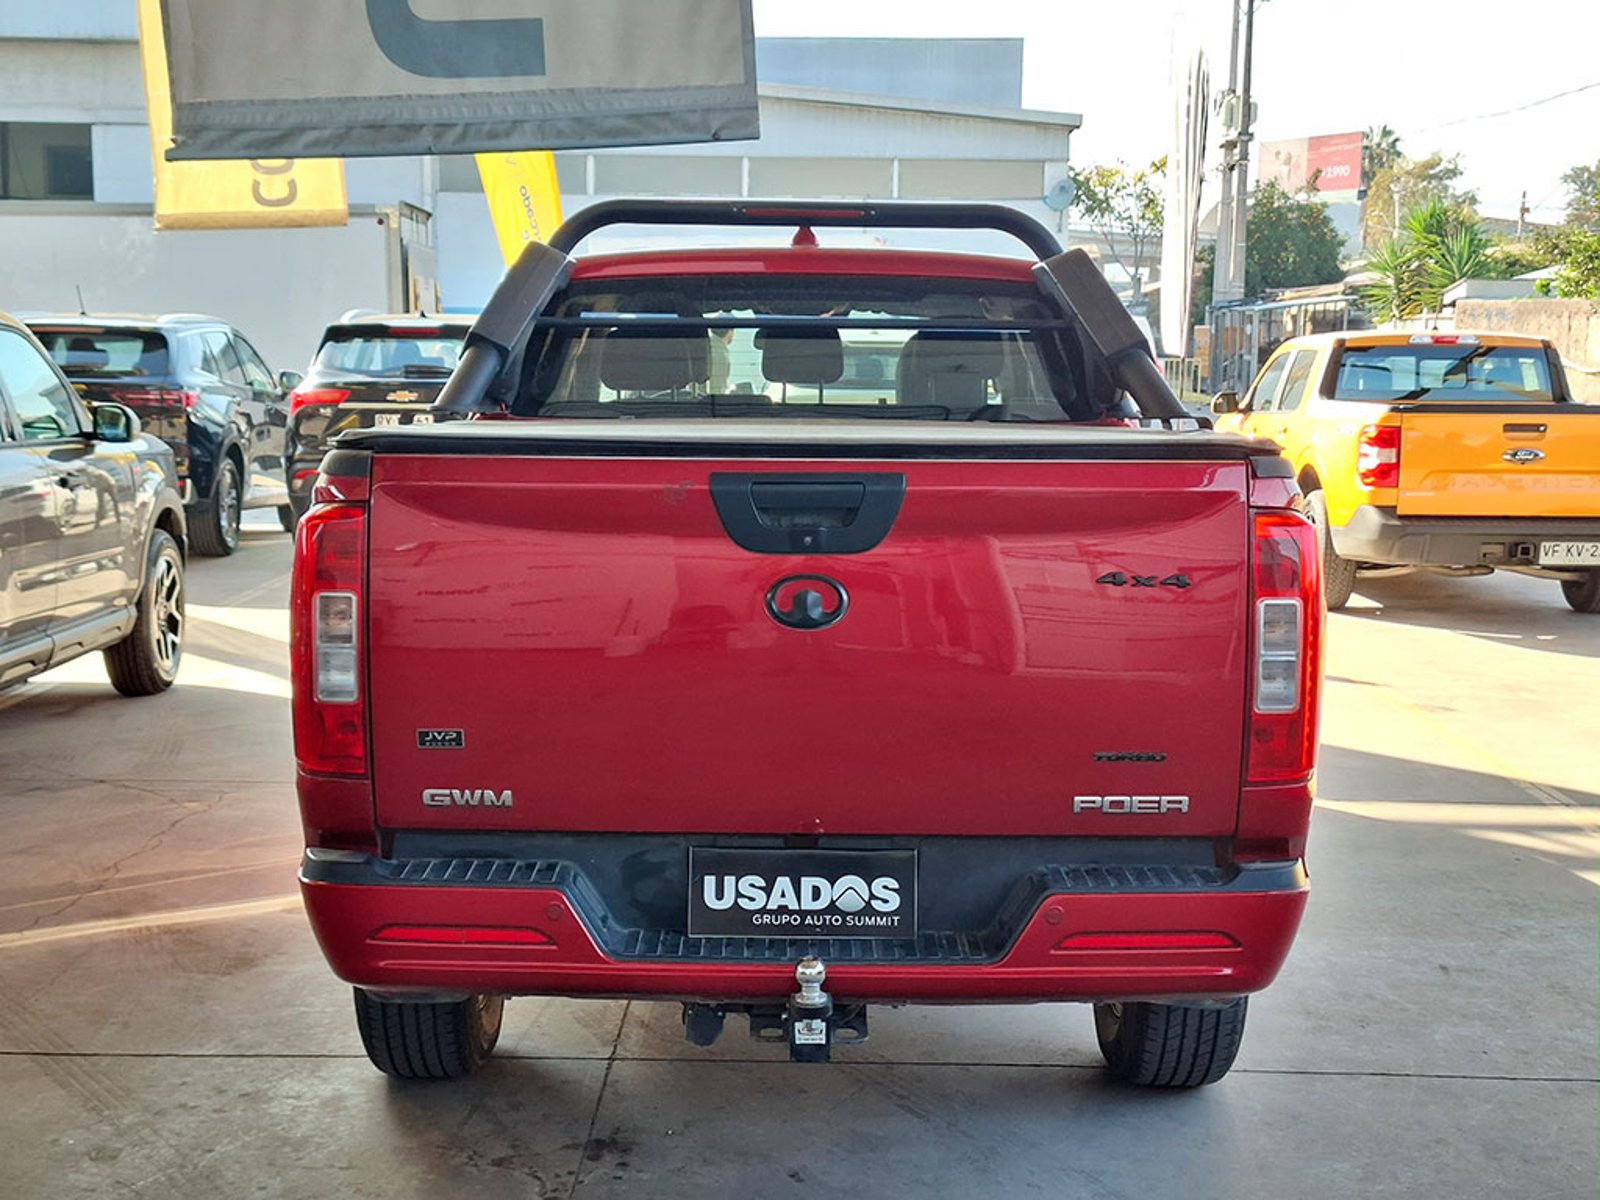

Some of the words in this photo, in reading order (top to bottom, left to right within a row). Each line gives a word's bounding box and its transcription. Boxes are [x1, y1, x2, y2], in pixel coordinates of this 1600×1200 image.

[1543, 543, 1560, 557] VF
[1095, 571, 1191, 589] 4x4
[422, 788, 513, 807] GWM
[1073, 795, 1190, 814] POER
[703, 874, 901, 912] USADOS
[752, 914, 801, 925] GRUPO
[804, 915, 842, 926] AUTO
[846, 915, 901, 926] SUMMIT
